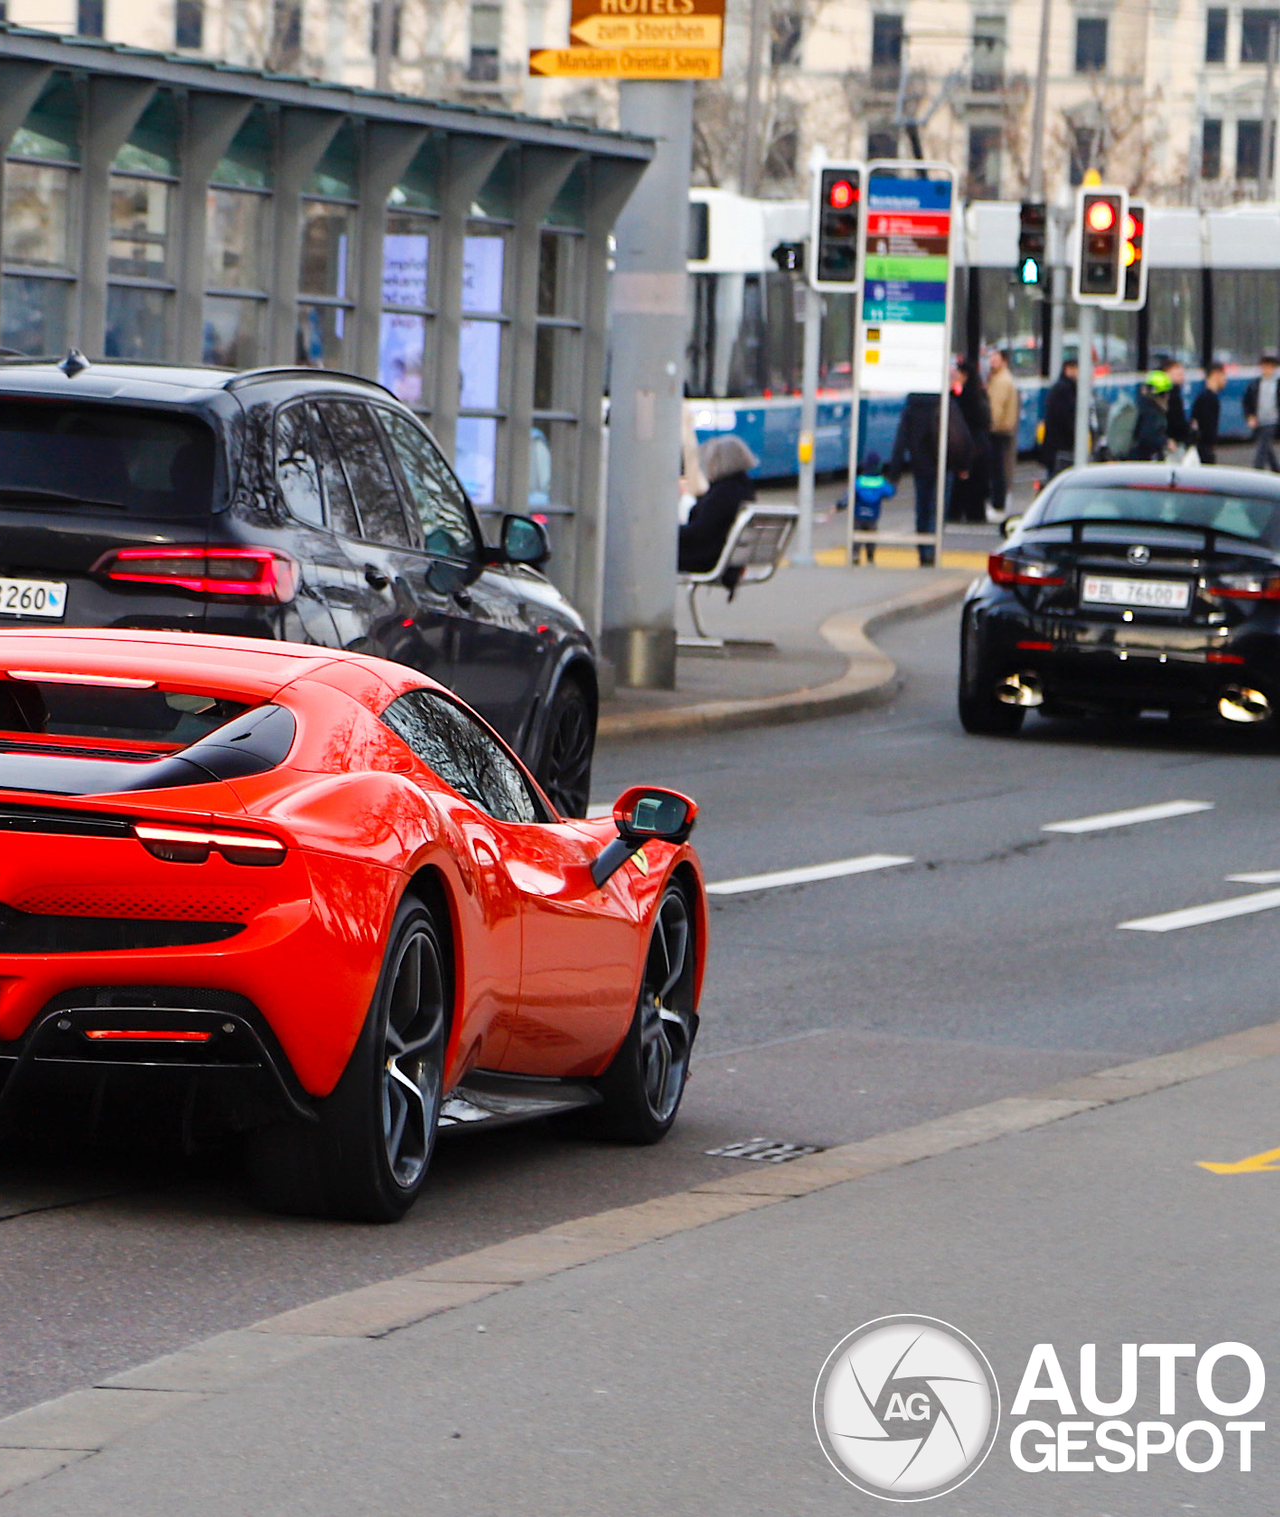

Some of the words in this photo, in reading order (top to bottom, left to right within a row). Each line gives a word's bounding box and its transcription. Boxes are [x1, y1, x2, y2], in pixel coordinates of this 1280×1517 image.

[600, 0, 695, 14] HOTELS
[597, 24, 630, 40] zum
[635, 21, 706, 40] Storchen
[557, 52, 617, 71] Mandarin
[621, 52, 670, 72] Oriental
[674, 54, 710, 76] Savoy
